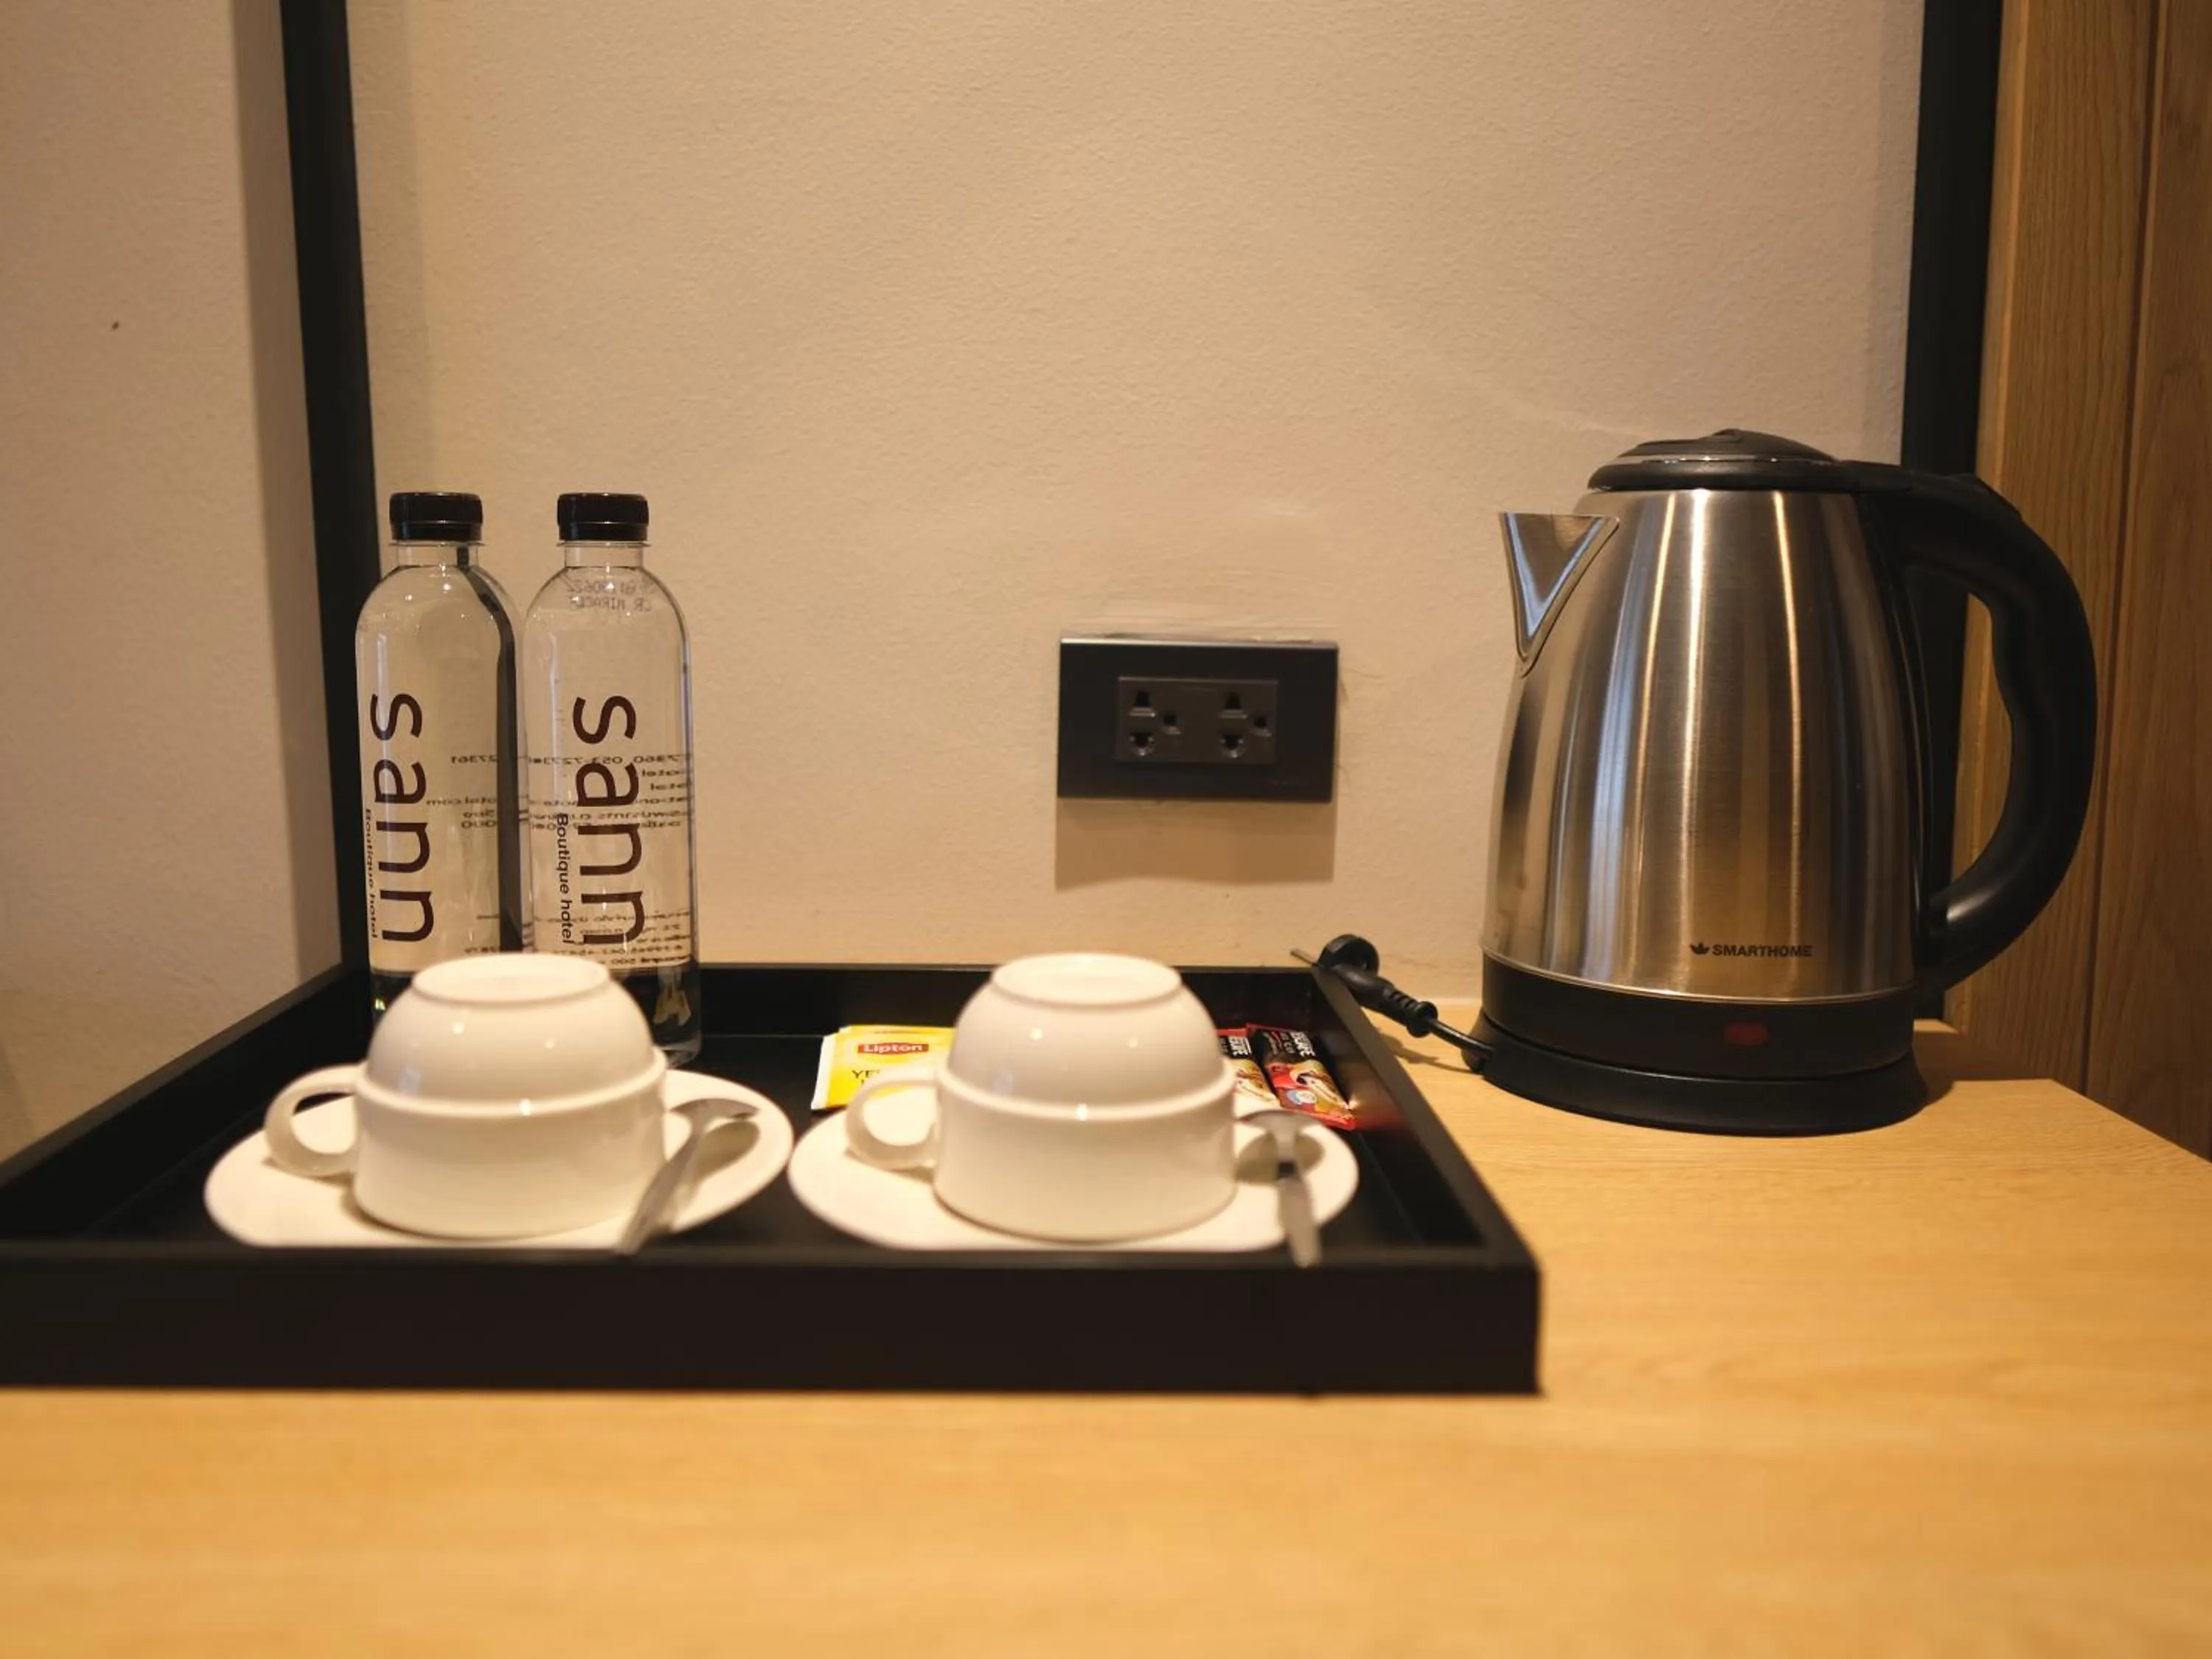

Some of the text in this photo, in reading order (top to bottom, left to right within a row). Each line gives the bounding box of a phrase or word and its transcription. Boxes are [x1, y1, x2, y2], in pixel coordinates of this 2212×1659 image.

[369, 693, 434, 942] sann
[556, 813, 575, 945] Boutique hotel
[572, 695, 645, 945] sann
[1711, 944, 1814, 957] SMARTHOME
[864, 1043, 923, 1054] Lipton
